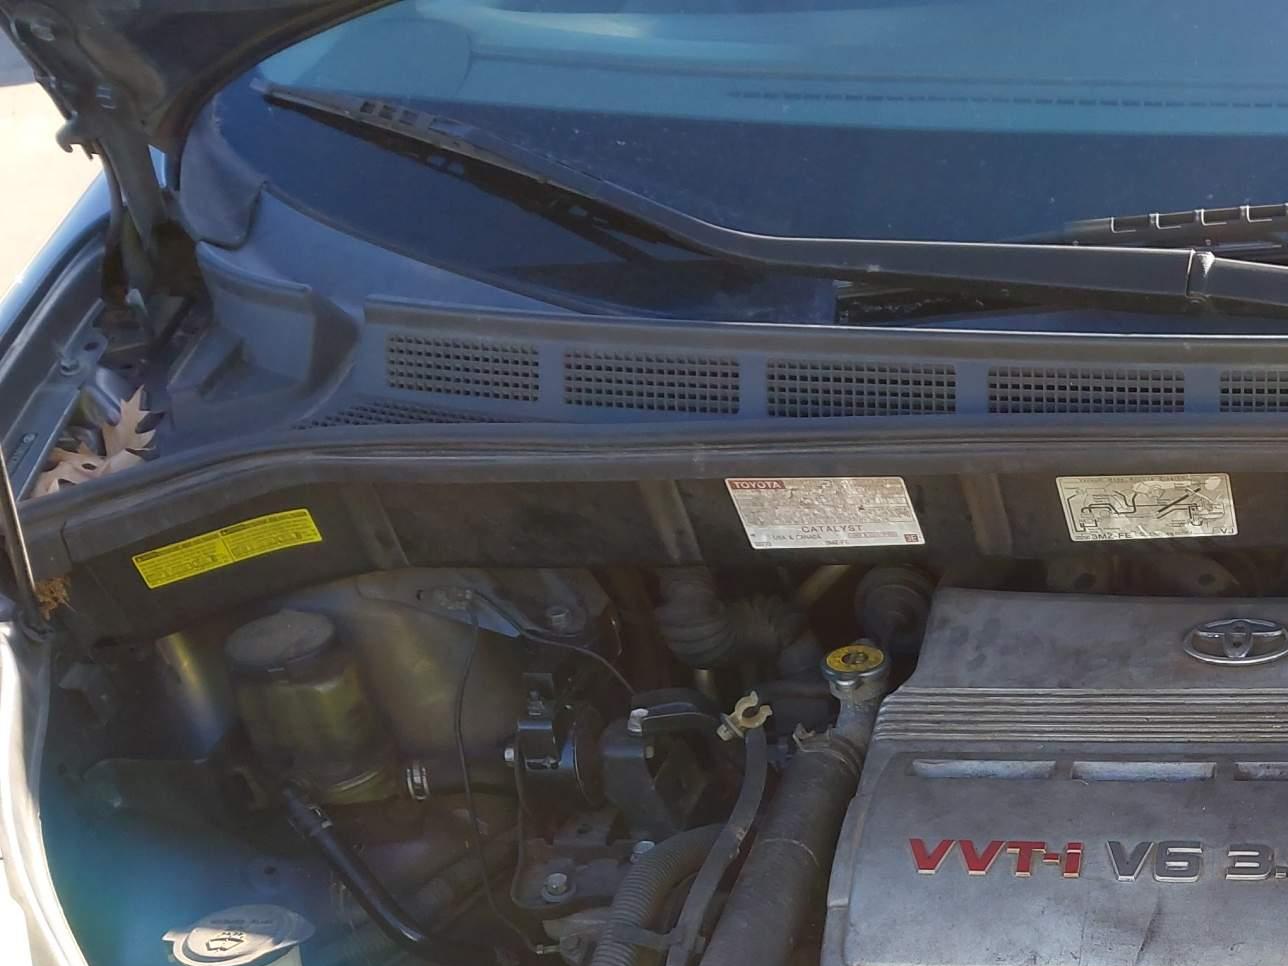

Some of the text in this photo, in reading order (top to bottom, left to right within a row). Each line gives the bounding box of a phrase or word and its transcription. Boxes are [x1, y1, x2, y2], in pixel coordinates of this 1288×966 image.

[734, 481, 782, 489] TOYOTA
[801, 524, 863, 533] CATALYST
[909, 838, 1083, 879] VVT-i
[1106, 840, 1202, 882] V6
